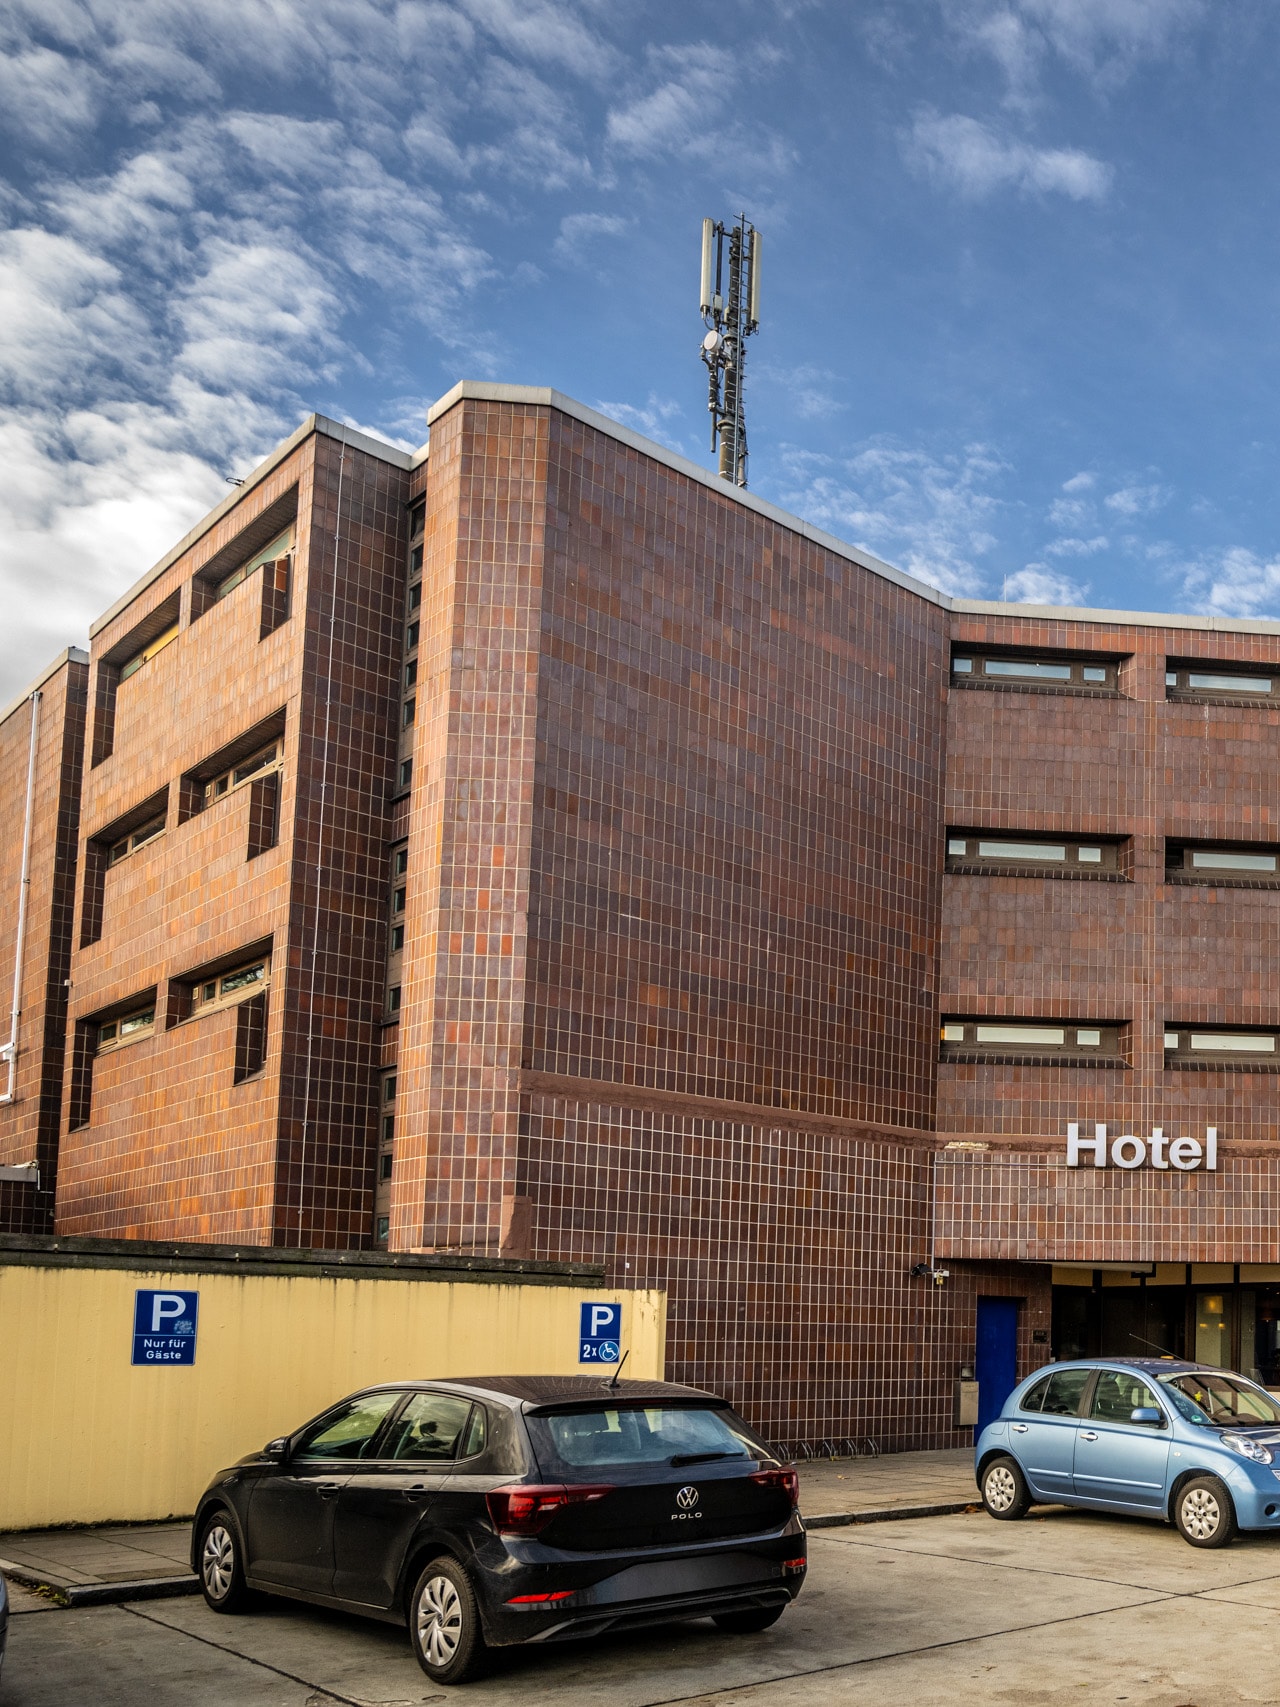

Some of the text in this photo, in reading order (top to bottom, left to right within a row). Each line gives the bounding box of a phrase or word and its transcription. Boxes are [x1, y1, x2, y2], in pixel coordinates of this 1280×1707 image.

[1067, 1122, 1218, 1171] Hotel
[151, 1294, 187, 1332] P
[591, 1305, 614, 1337] P
[143, 1338, 187, 1348] Nur für
[146, 1350, 182, 1360] Gäste
[671, 1511, 702, 1521] POLO
